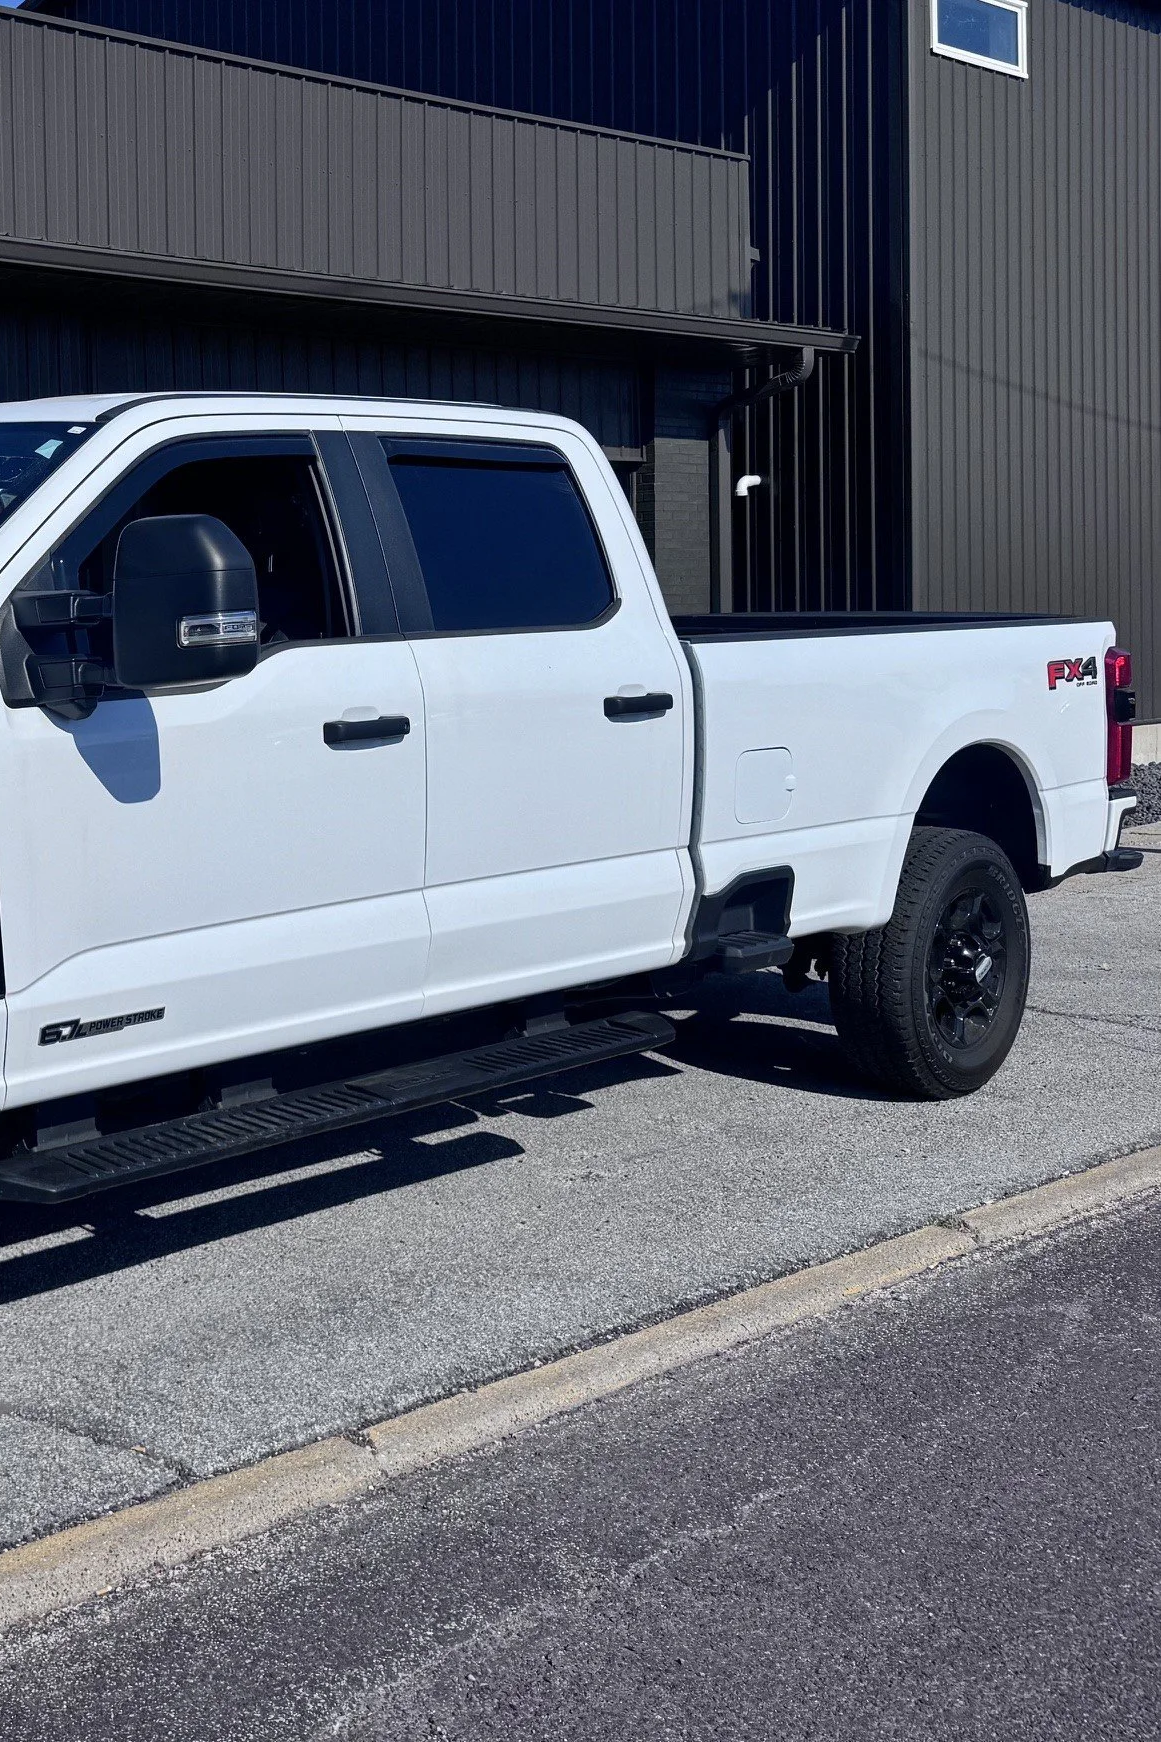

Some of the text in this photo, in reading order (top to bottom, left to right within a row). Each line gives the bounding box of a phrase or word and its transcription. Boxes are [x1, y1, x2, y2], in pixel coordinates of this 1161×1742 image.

[1047, 656, 1098, 691] FX4
[89, 1016, 124, 1031] POWER
[125, 1008, 165, 1025] STROKE
